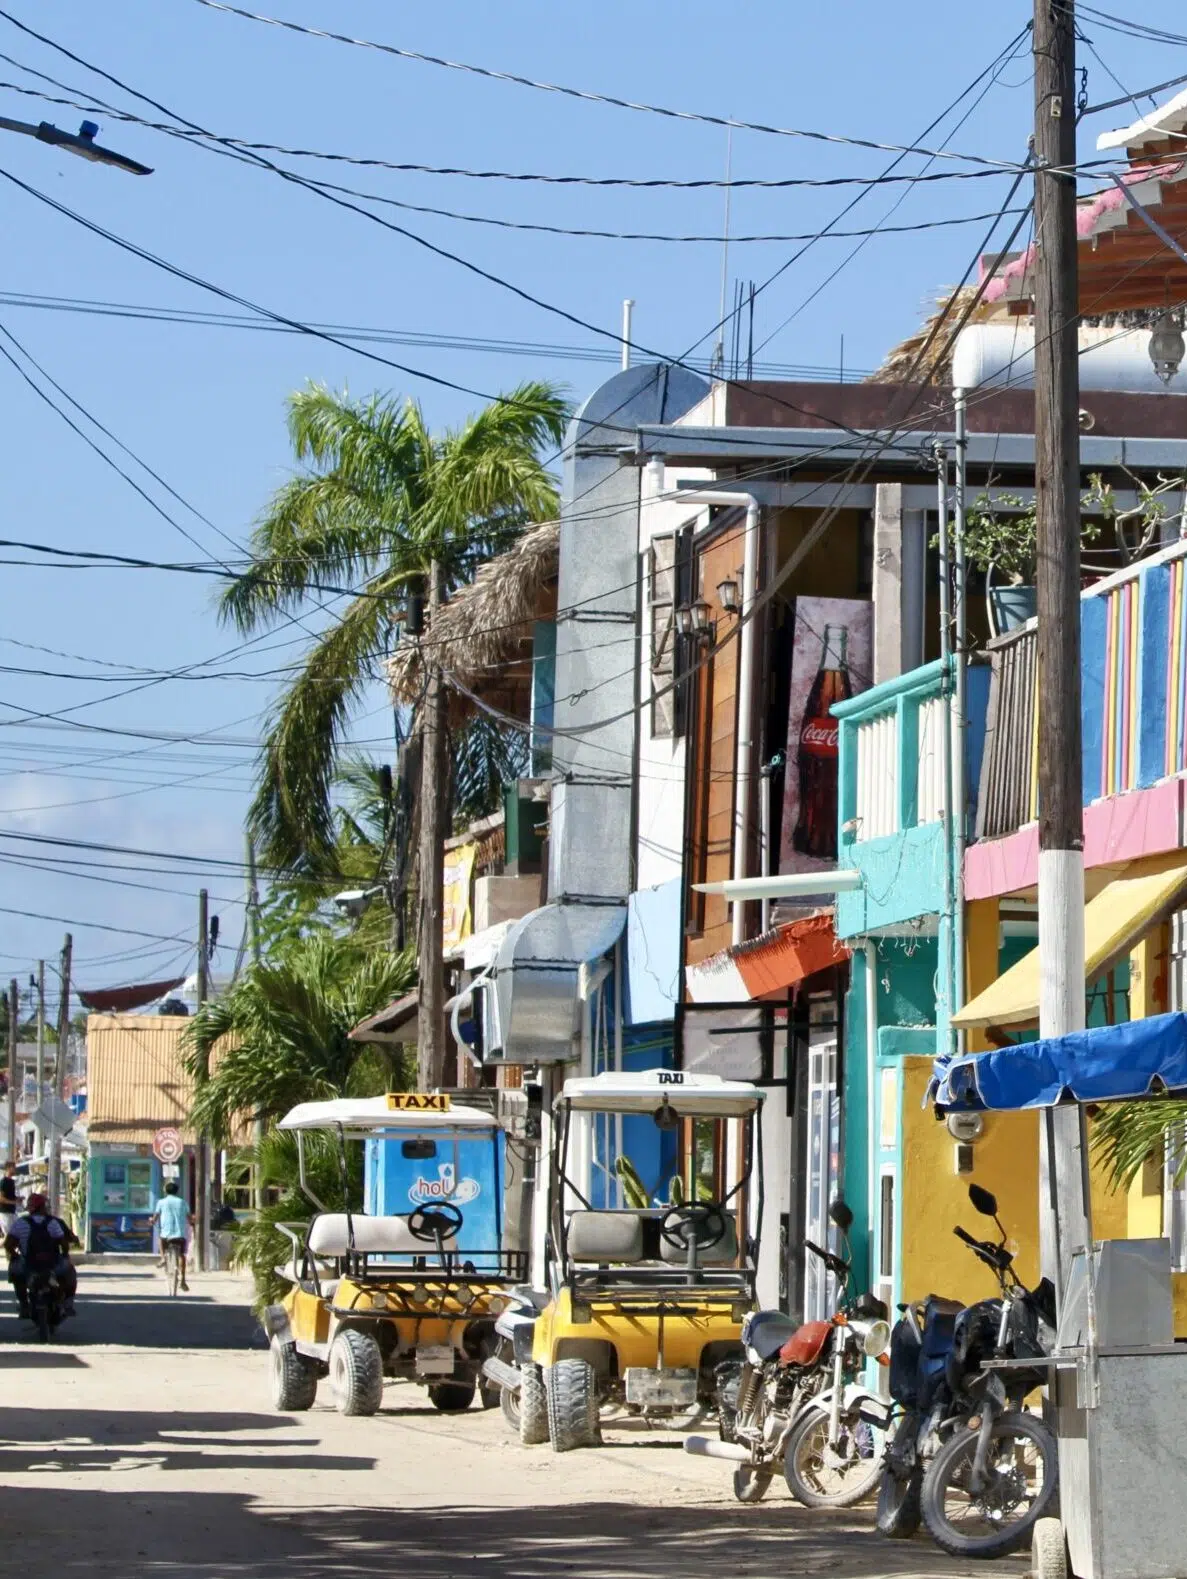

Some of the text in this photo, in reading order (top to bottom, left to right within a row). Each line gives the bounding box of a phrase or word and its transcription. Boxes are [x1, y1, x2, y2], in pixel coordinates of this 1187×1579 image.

[801, 723, 838, 746] Coca-C
[657, 1072, 684, 1085] TAXI
[389, 1095, 446, 1109] TAXI
